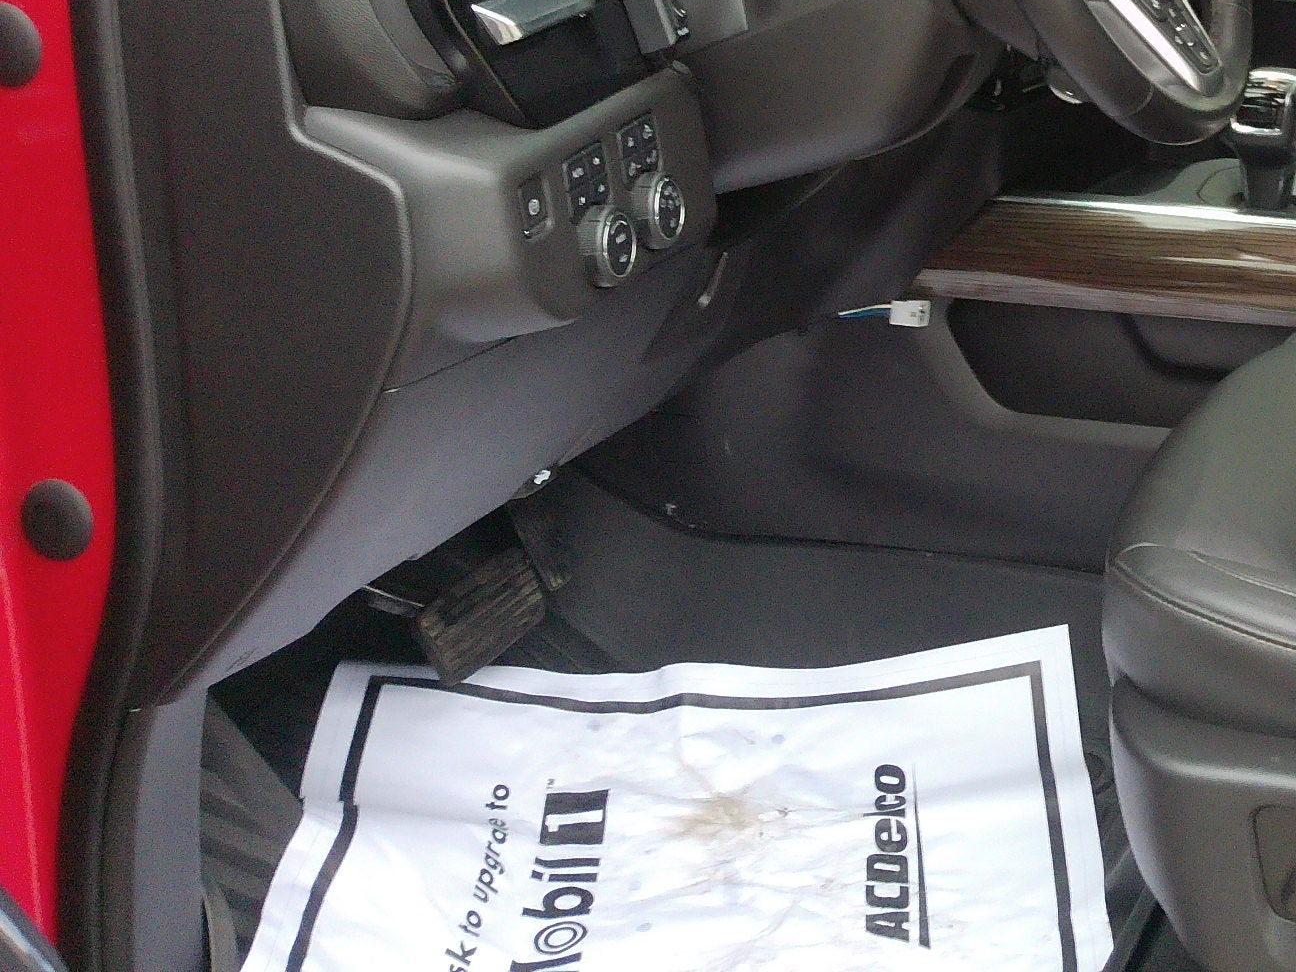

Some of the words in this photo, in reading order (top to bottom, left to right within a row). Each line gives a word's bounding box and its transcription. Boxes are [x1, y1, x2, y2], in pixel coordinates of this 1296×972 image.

[485, 784, 510, 810] to
[473, 817, 509, 903] upgrae
[862, 763, 910, 942] ACDelco
[458, 909, 482, 937] to
